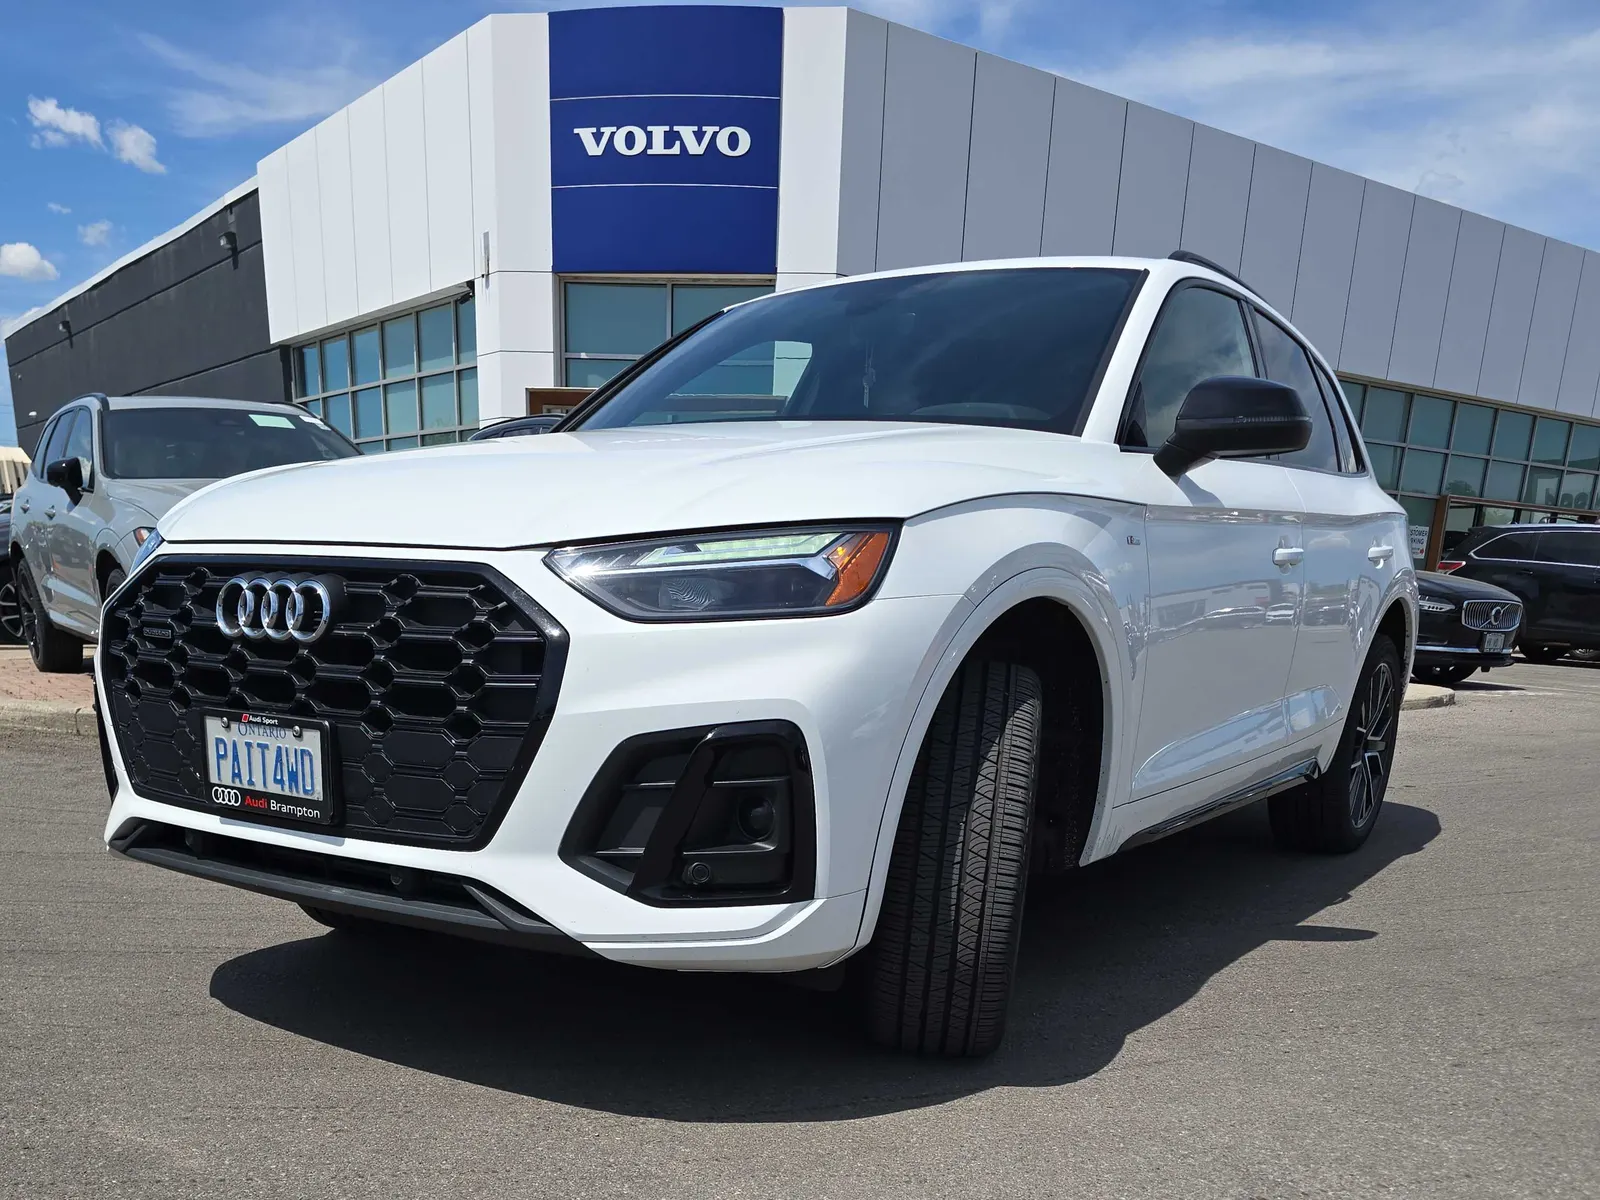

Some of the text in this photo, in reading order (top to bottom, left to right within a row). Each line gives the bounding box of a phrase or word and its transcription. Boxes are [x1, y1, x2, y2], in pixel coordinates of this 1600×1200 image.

[573, 125, 751, 157] VOLVO
[249, 714, 279, 725] Audi Sport
[238, 722, 287, 740] ONTARIO
[214, 736, 316, 796] PAIT4WD
[244, 796, 321, 818] Audi Brampton
